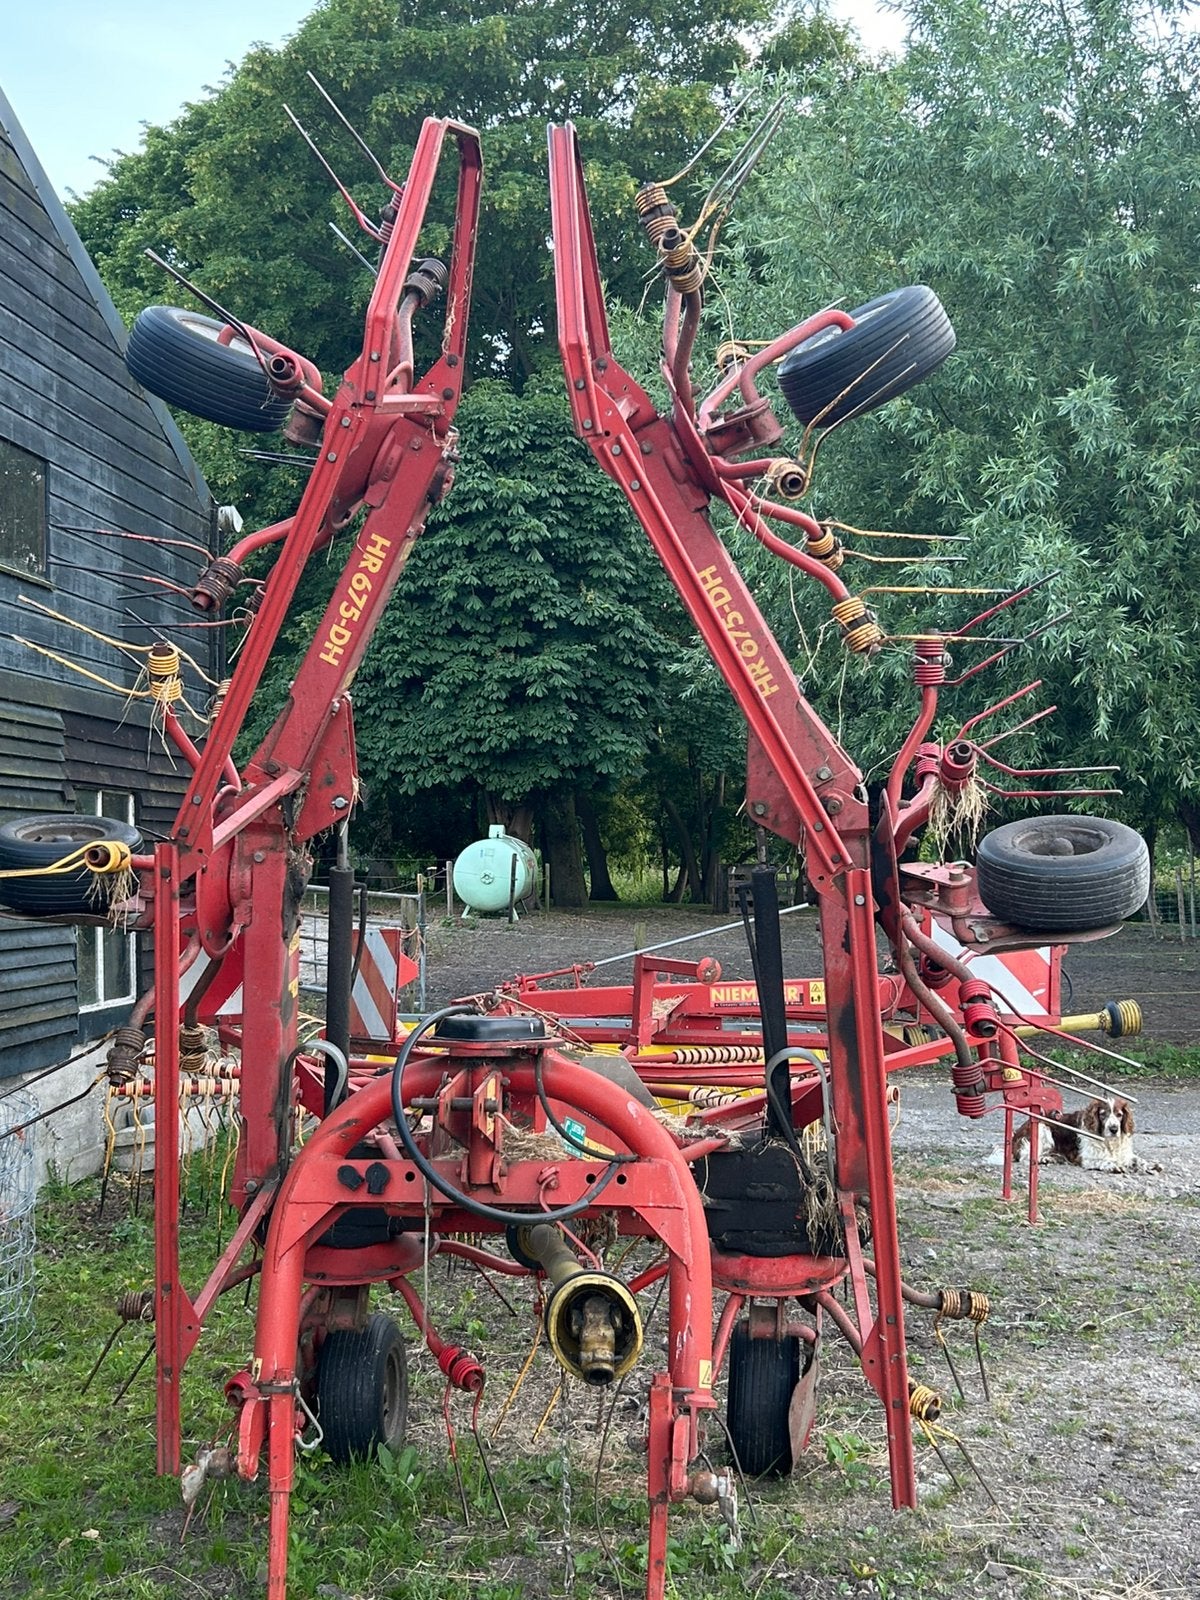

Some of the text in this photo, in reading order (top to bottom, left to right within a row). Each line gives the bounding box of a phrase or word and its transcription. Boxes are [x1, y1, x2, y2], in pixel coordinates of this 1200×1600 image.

[319, 533, 392, 667] HR 675-DH
[746, 656, 780, 697] HR
[711, 986, 799, 1002] NIEMR
